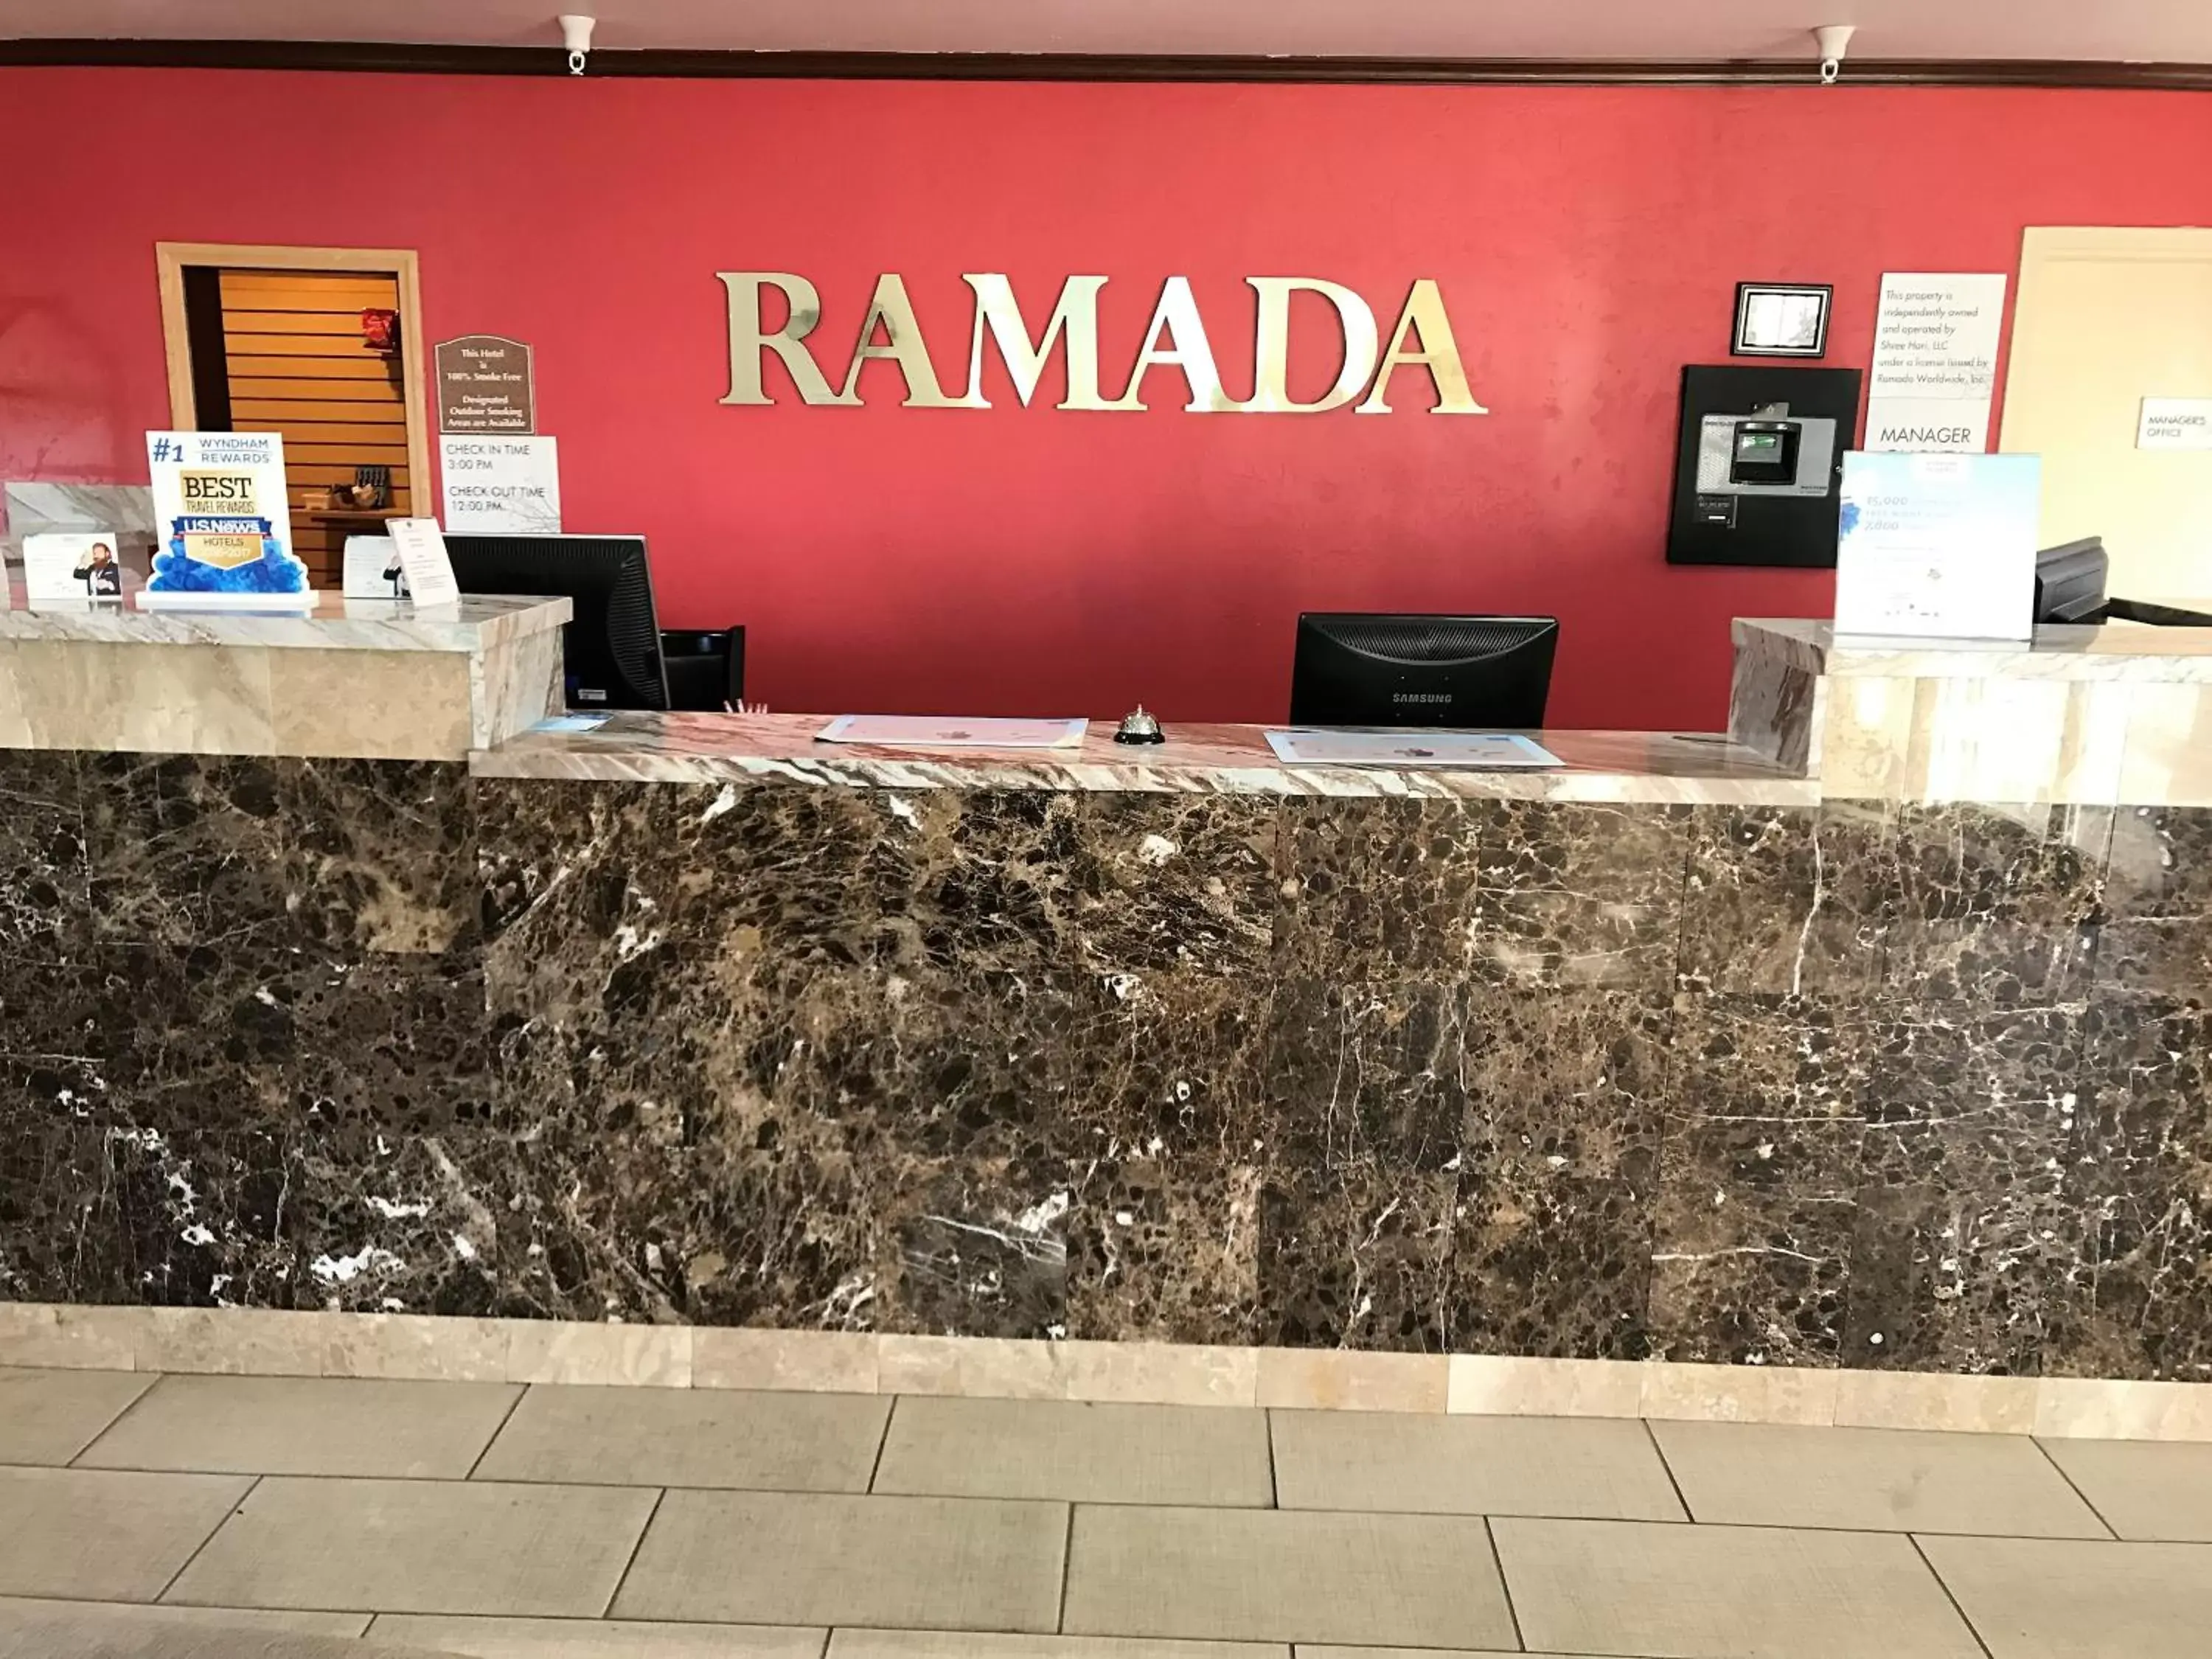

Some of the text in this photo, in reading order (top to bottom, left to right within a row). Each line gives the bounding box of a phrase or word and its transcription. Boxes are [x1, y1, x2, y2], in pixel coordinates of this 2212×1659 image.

[1886, 290, 1954, 303] This property is
[1883, 307, 1979, 319] independently owned
[1882, 323, 1957, 336] and operated by
[717, 271, 1489, 414] RAMADA
[1879, 340, 1906, 350] Shree
[1932, 341, 1949, 350] LLC
[461, 348, 504, 358] This Hotel
[1877, 357, 1904, 366] under
[1976, 357, 1989, 368] by
[473, 372, 501, 381] Smoke
[503, 373, 522, 381] Free
[1877, 373, 1914, 383] Ramada
[462, 394, 509, 406] Designated
[449, 406, 523, 417] Outdoor Smoking
[448, 418, 471, 427] Areas
[488, 418, 526, 428] Available
[1880, 427, 1972, 443] MANAGER
[199, 439, 269, 448] WYNDHAM
[153, 438, 184, 462] #1
[446, 444, 530, 455] CHECK IN TIME
[201, 453, 270, 464] REWARDS
[448, 459, 493, 470] 3:00 PM
[184, 477, 252, 498] BEST
[448, 486, 546, 498] CHECK OUT TIME
[187, 501, 255, 514] TRAVEL REWARDS
[452, 501, 483, 511] 12:00
[203, 538, 244, 546] HOTELS
[1393, 694, 1452, 703] SAMSUNG
